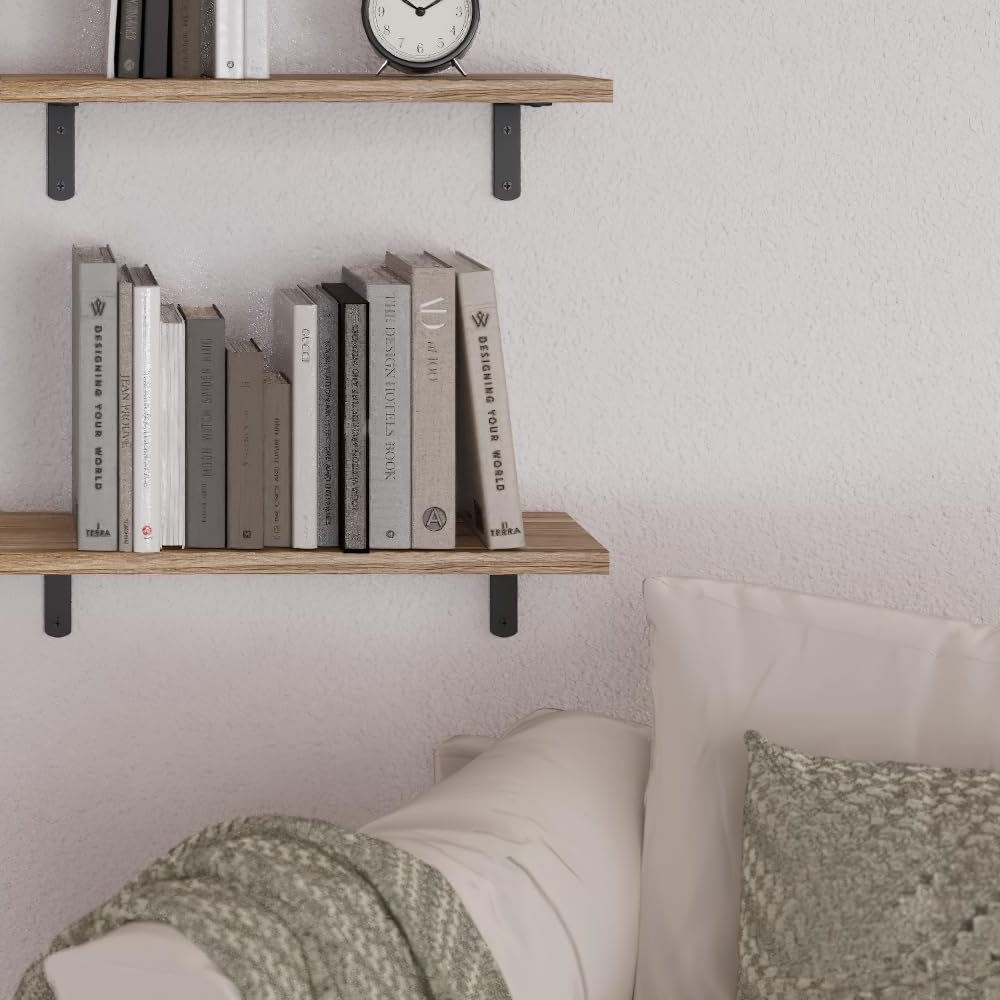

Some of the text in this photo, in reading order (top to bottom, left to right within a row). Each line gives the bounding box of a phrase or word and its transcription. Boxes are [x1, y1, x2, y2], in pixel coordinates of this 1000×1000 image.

[120, 374, 131, 401] JEAN
[301, 328, 311, 362] GUCCI
[385, 295, 396, 481] THE DESIGN HOTELS BOOK
[94, 324, 103, 490] DESIGNING YOUR WORLD
[478, 335, 506, 492] DESIGNING YOUR WORLD
[490, 528, 521, 537] TERRA
